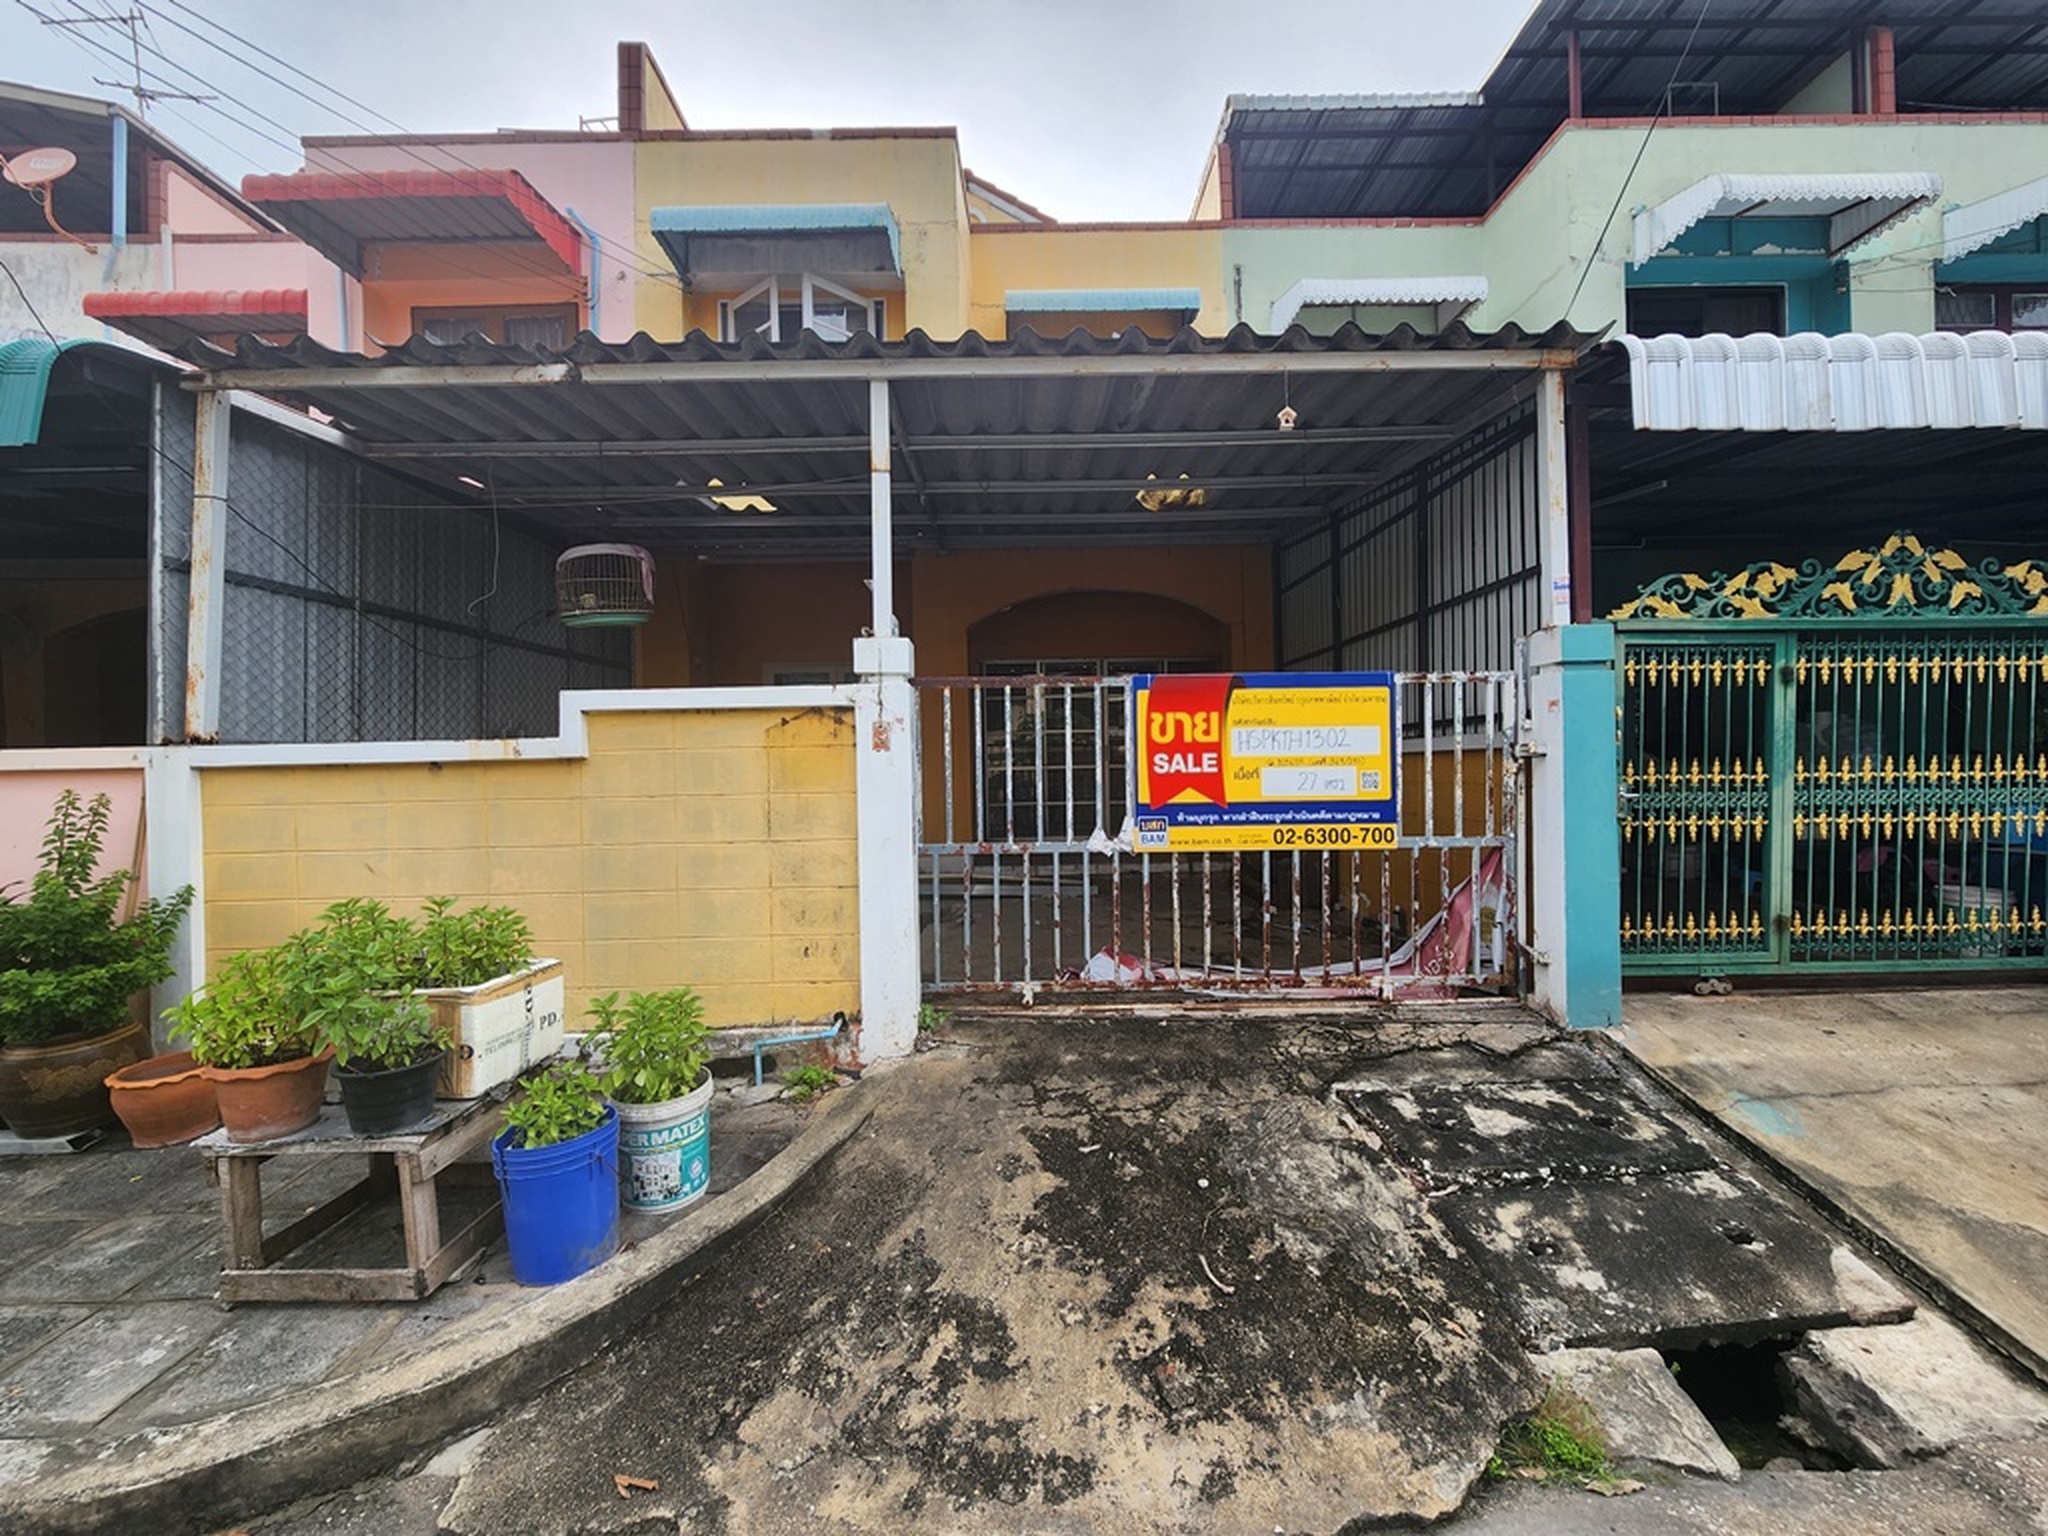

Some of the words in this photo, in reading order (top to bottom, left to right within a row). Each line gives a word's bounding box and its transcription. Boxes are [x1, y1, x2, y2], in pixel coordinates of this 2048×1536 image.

[1150, 711, 1220, 745] ขาย
[1153, 753, 1219, 774] SALE
[1297, 771, 1318, 791] 27
[1140, 832, 1166, 845] BAM
[1273, 827, 1395, 846] 02-6300-700
[620, 1131, 649, 1147] PER
[650, 1112, 706, 1146] MATEX
